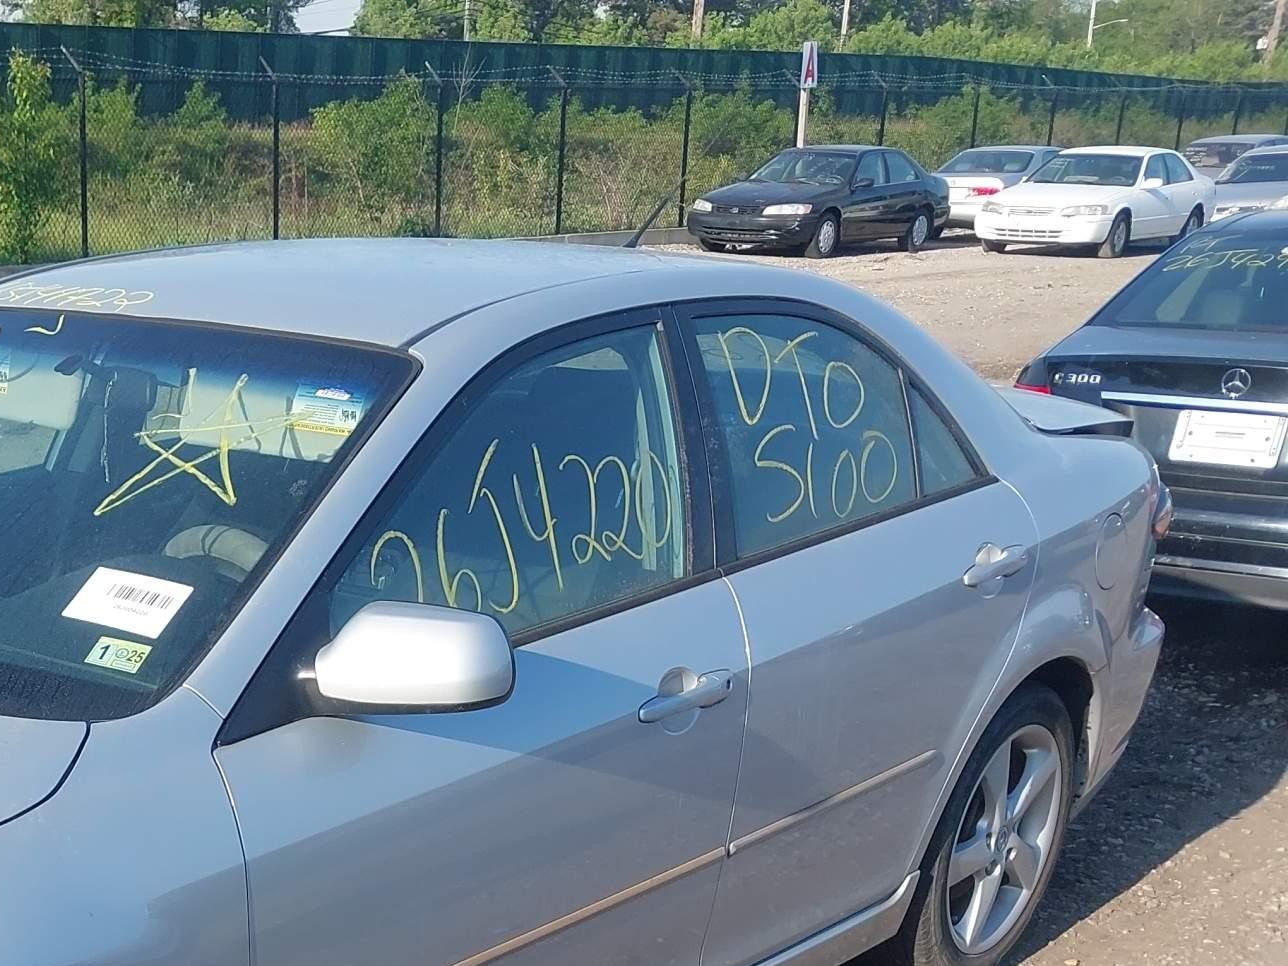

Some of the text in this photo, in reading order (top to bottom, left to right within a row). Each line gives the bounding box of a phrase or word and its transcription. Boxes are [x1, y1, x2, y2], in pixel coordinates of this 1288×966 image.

[804, 42, 815, 84] A
[718, 326, 864, 441] DTO
[1066, 373, 1101, 384] 300
[99, 644, 145, 664] 1 25
